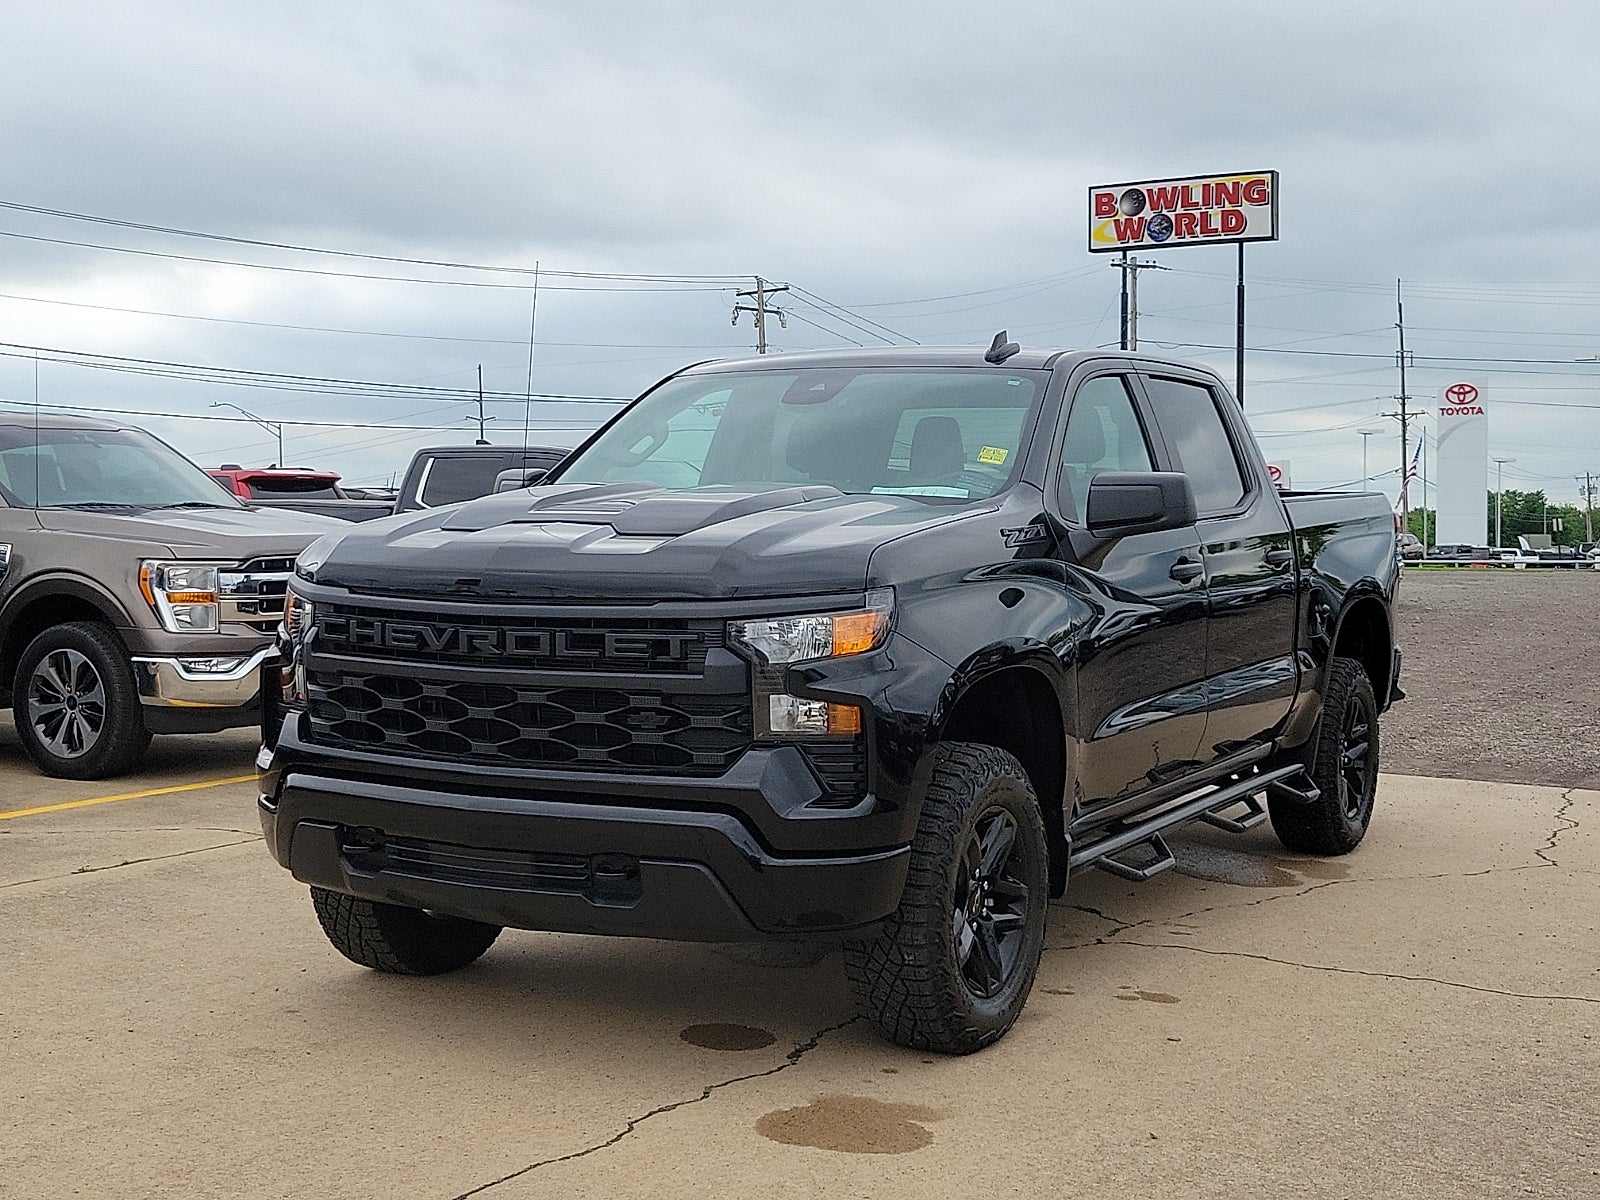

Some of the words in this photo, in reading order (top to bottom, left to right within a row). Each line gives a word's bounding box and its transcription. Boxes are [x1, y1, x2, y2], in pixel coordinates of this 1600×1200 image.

[1094, 179, 1269, 218] BOWLING
[1113, 210, 1247, 243] WORLD
[1439, 406, 1484, 416] TOYOTA
[318, 616, 699, 660] CHEVROLET
